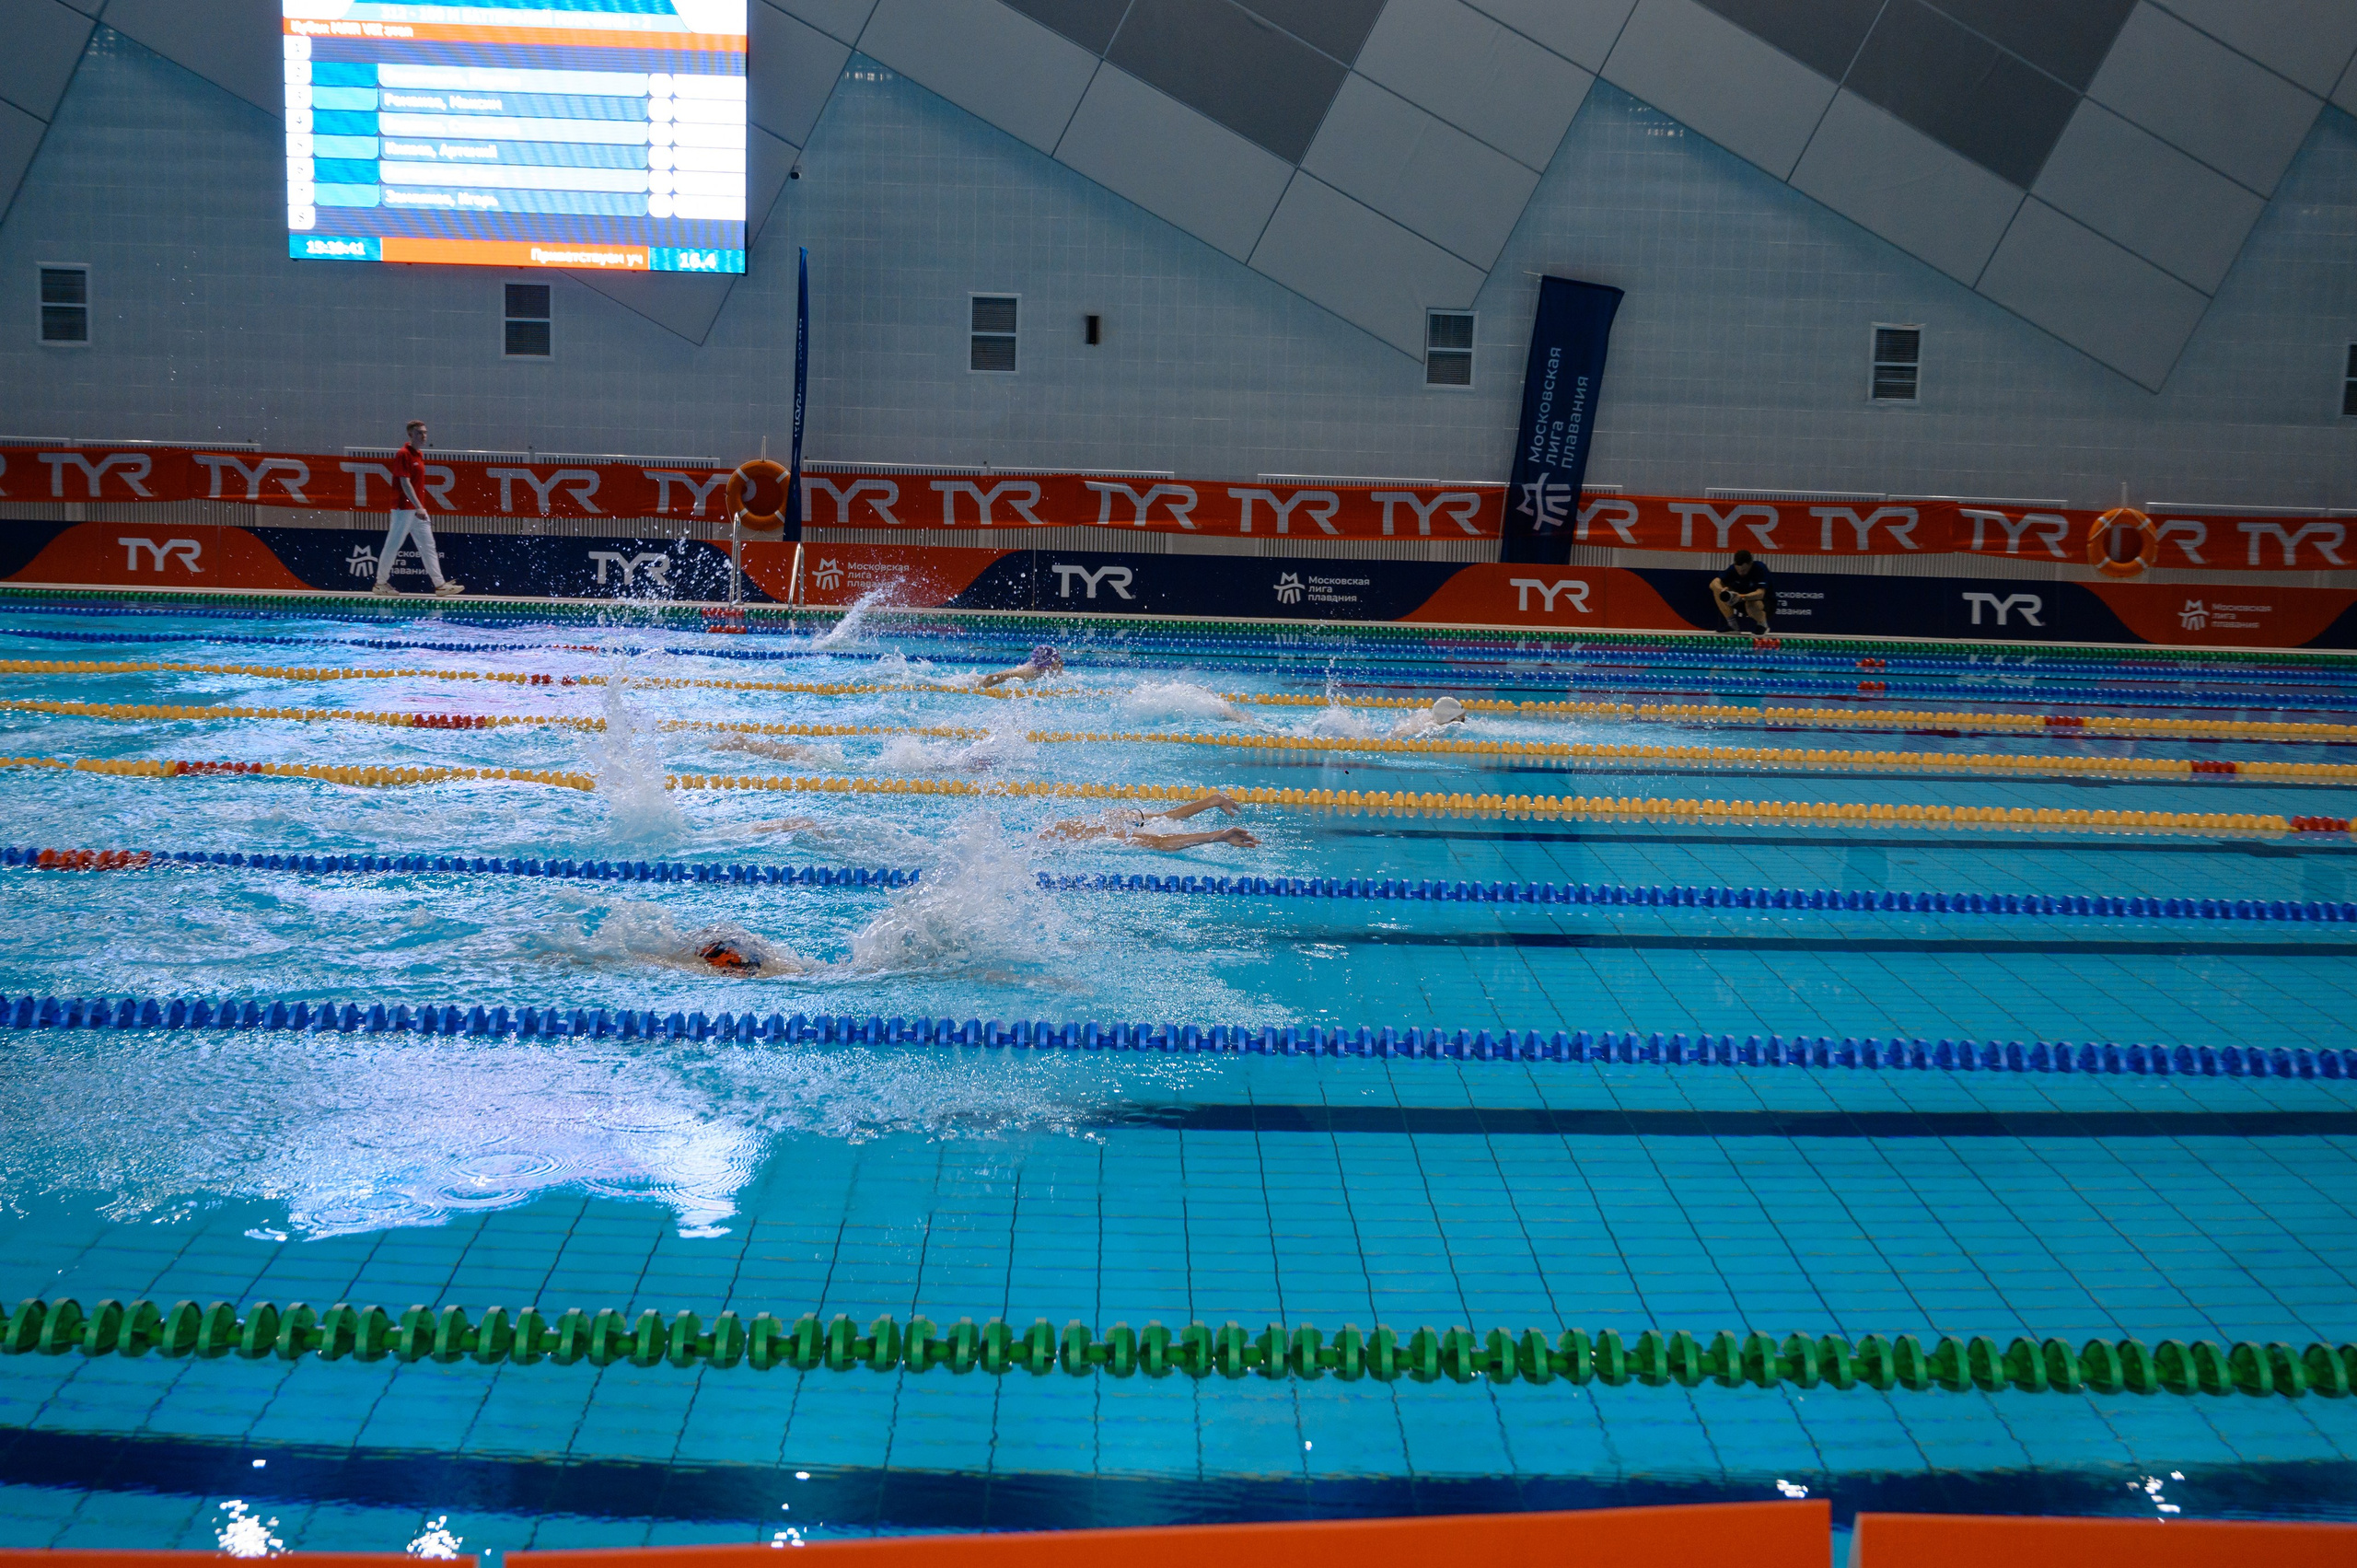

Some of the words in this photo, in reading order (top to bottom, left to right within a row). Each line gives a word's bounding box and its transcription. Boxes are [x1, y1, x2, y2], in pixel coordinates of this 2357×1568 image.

[679, 253, 716, 269] 16.4
[1528, 347, 1562, 463] Московская
[1561, 376, 1589, 469] плавания
[1546, 421, 1564, 466] лига
[38, 453, 154, 497] TYR
[192, 454, 311, 504] TYR
[340, 461, 458, 511] TR
[486, 468, 603, 514] TYR
[643, 470, 757, 517] TY
[930, 481, 1045, 525] TYR
[1085, 481, 1199, 530] TYR
[1227, 488, 1341, 535] TYR
[1371, 491, 1482, 536] TYR
[1667, 502, 1780, 550] TYR
[1809, 506, 1919, 551] TYR
[1959, 507, 2070, 558] TYR
[2236, 522, 2347, 566] TYR
[118, 538, 203, 573] TYR
[588, 551, 671, 587] TYR
[847, 562, 910, 572] Московская
[1051, 564, 1133, 599] TYR
[1307, 594, 1357, 602] плавания
[1308, 575, 1370, 586] Московская
[1510, 578, 1591, 613] TYR
[1962, 592, 2044, 627] TYR
